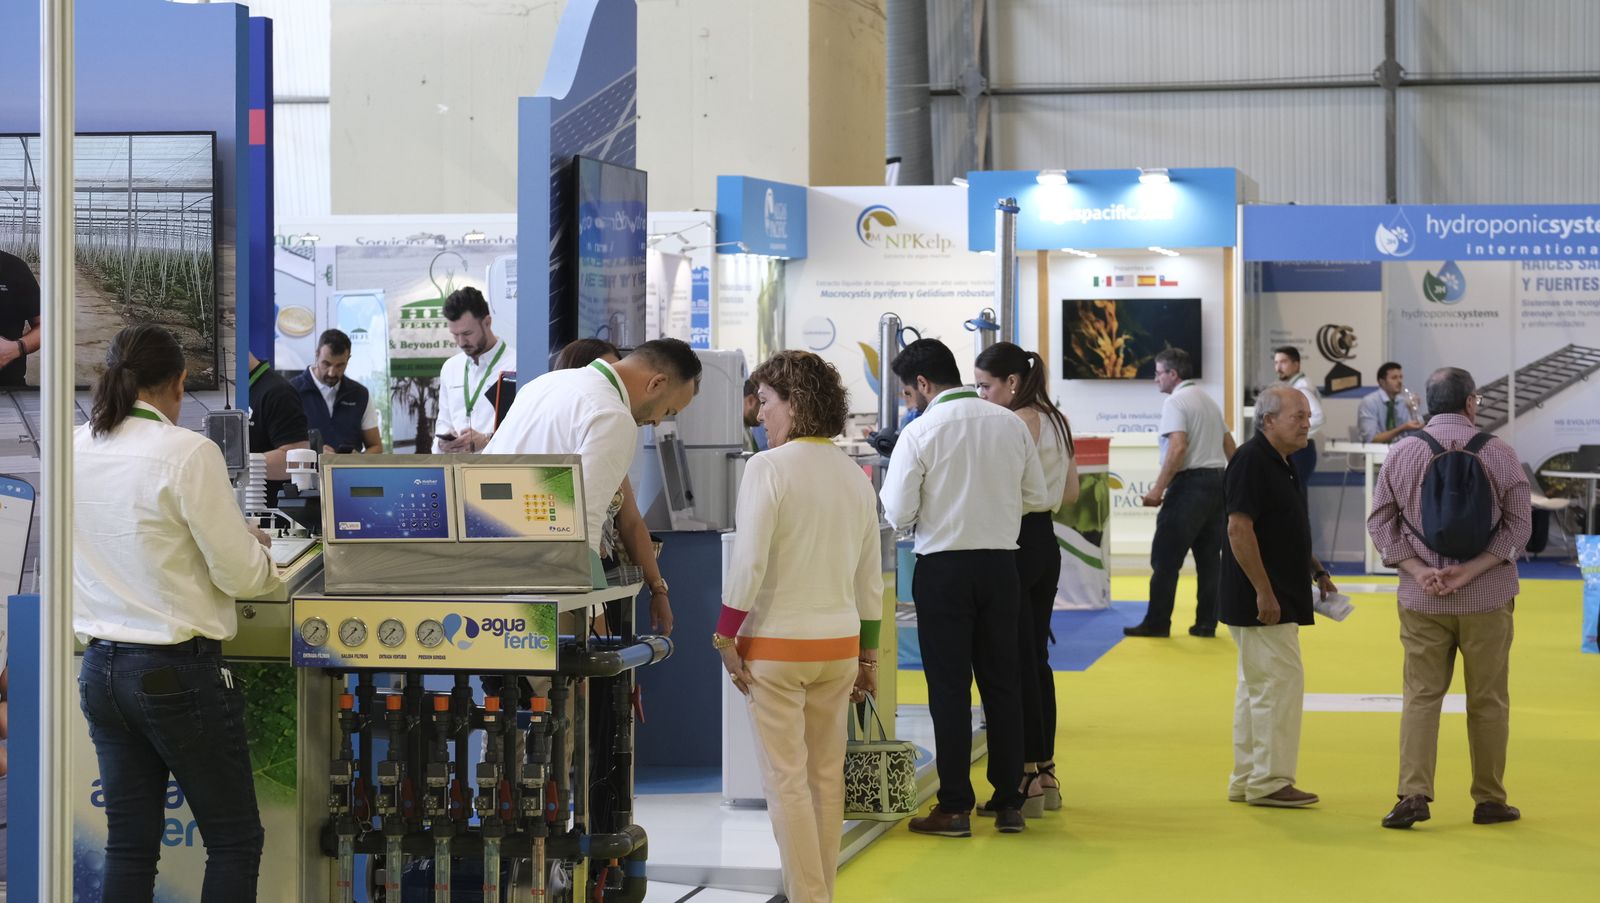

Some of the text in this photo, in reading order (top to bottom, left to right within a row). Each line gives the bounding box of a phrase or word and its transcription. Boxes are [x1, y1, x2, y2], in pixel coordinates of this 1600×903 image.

[1522, 277, 1600, 291] Y FUERTES
[820, 290, 870, 299] Macrocystis
[916, 289, 955, 298] Gelidium
[400, 340, 440, 351] Beyond
[481, 617, 526, 637] agua
[504, 632, 549, 649] fertic
